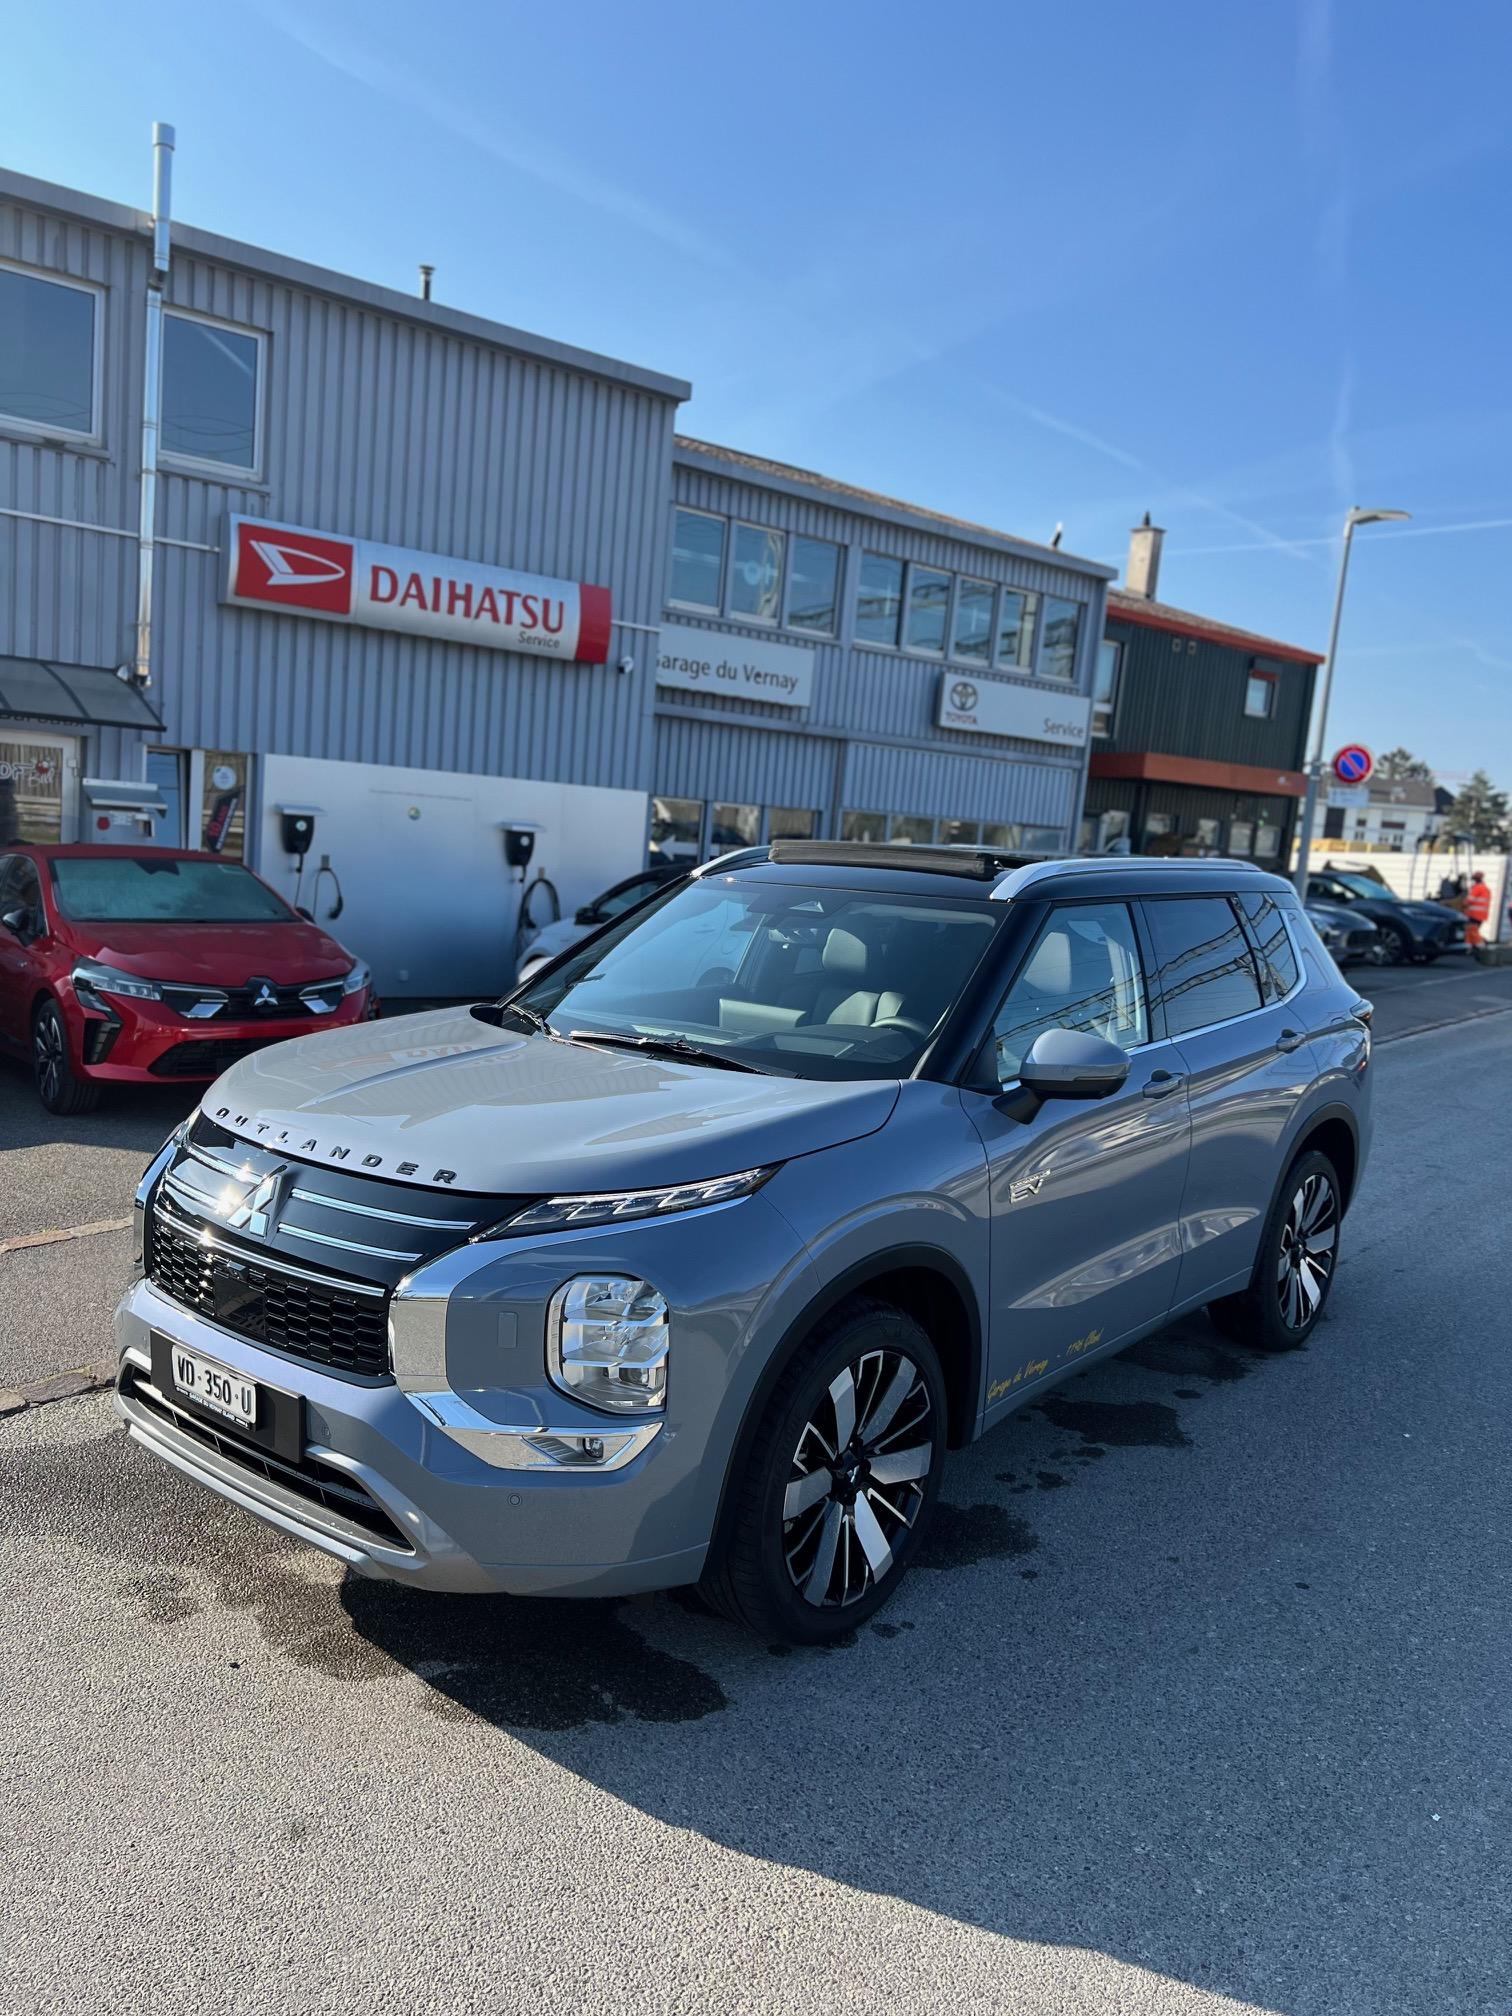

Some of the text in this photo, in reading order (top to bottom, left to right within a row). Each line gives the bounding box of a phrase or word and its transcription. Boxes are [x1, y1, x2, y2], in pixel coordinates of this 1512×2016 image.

[369, 564, 564, 633] DAIHATSU
[517, 631, 560, 649] Service
[715, 660, 738, 680] du
[743, 664, 798, 695] Vernay
[945, 711, 978, 726] TOYOTA
[1043, 717, 1084, 739] Service
[215, 1107, 457, 1185] OUTLANDER
[177, 1355, 252, 1416] VD 350 U
